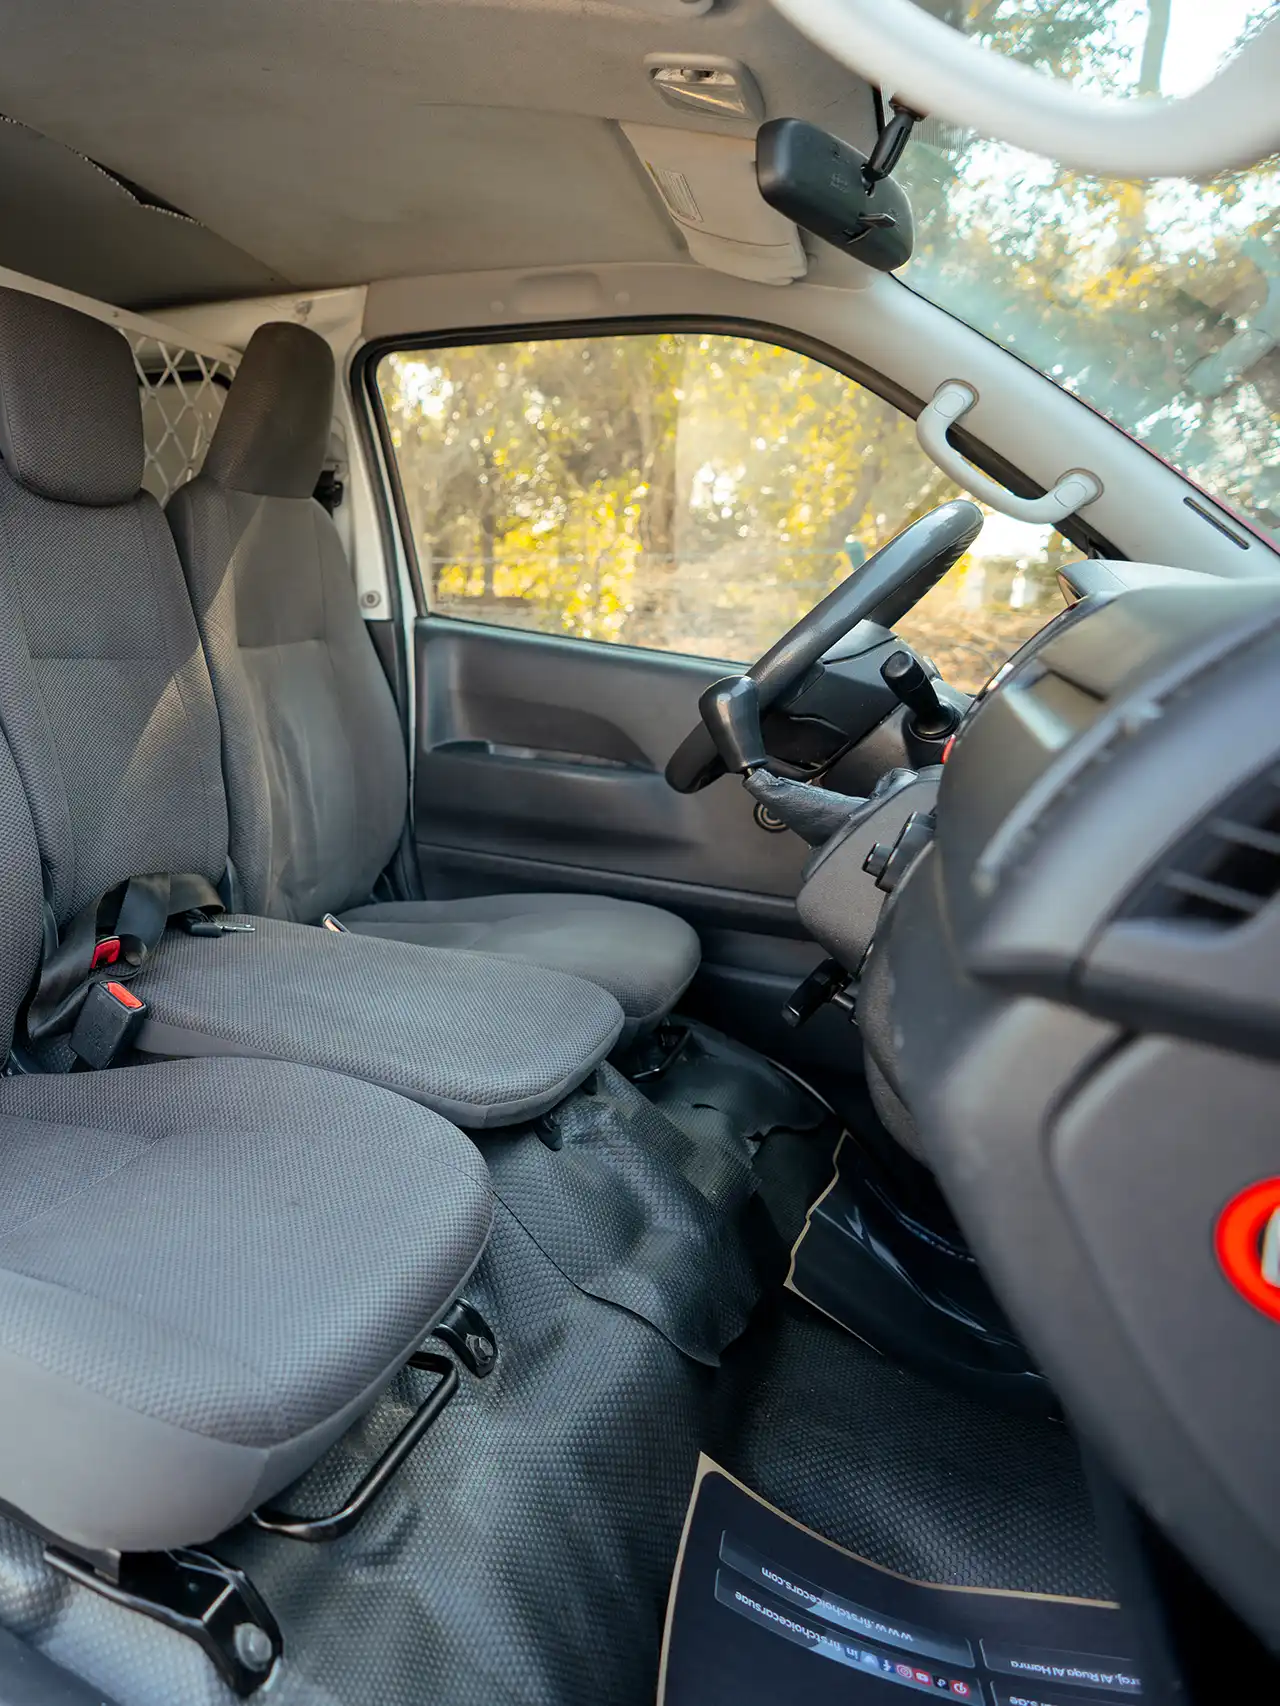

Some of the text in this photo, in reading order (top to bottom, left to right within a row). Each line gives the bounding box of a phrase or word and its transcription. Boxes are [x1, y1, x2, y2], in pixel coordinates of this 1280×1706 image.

[734, 1590, 842, 1652] firstchoicecarsuae
[761, 1566, 914, 1642] www.firstchoicecars.com
[1010, 1660, 1051, 1677] Hamra
